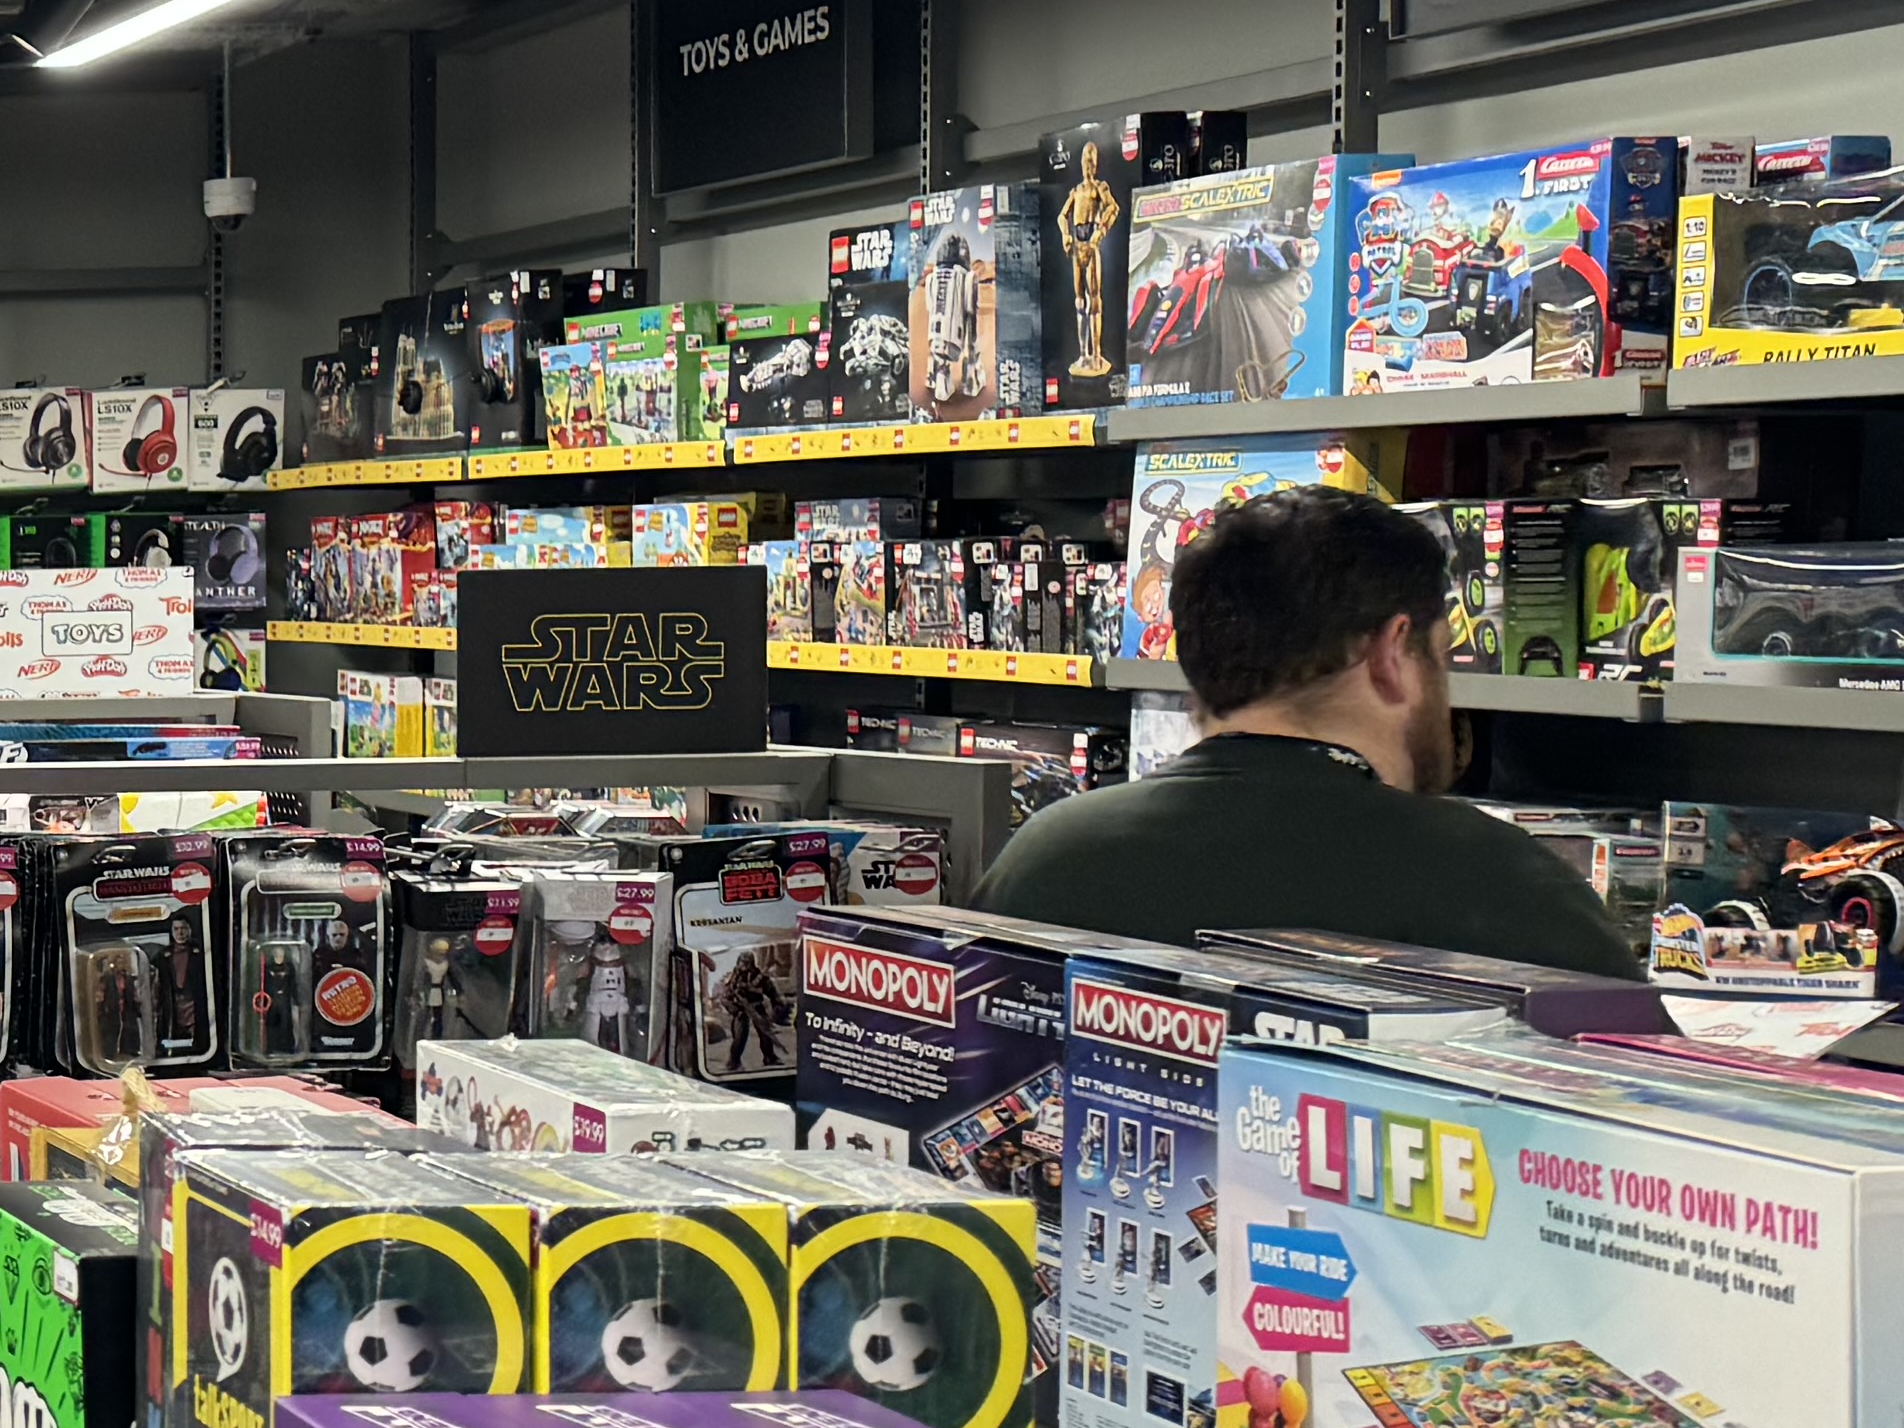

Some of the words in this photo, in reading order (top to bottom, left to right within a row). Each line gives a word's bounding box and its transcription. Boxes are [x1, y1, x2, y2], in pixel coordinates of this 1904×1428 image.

[678, 34, 730, 79] TOYS
[733, 28, 751, 60] &
[753, 4, 830, 57] GAMES
[51, 623, 123, 644] TOYS
[502, 613, 724, 662] STAR
[503, 661, 724, 712] WARS
[789, 838, 827, 852] £27.99
[809, 947, 949, 1014] MONOPOLY
[805, 1012, 821, 1027] To
[823, 1017, 866, 1043] Infinity
[875, 1030, 899, 1048] and
[902, 1036, 955, 1062] Beyond!
[1076, 990, 1221, 1057] MONOPOLY
[1250, 1085, 1280, 1123] the
[1235, 1106, 1301, 1157] Game
[1279, 1150, 1300, 1185] of
[1307, 1105, 1479, 1224] LIFE
[1518, 1148, 1604, 1201] CHOOSE
[1610, 1168, 1672, 1217] YOUR
[1679, 1184, 1737, 1232] OWN
[1746, 1198, 1820, 1250] PATH!
[1546, 1200, 1573, 1221] Take
[1577, 1213, 1585, 1226] a
[1588, 1213, 1614, 1234] spin
[1617, 1221, 1640, 1239] and
[1643, 1225, 1686, 1251] buckle
[1690, 1239, 1706, 1259] up
[1711, 1240, 1730, 1261] for
[1251, 1240, 1285, 1267] MAKE
[1287, 1249, 1317, 1273] YOUR
[1319, 1257, 1349, 1282] RIDE
[1539, 1226, 1570, 1248] turns
[1575, 1237, 1596, 1254] and
[1600, 1241, 1669, 1272] adventures
[1674, 1258, 1690, 1277] all
[1693, 1265, 1729, 1293] along
[1732, 1273, 1754, 1294] the
[1759, 1282, 1795, 1304] road!
[1253, 1301, 1345, 1340] COLOURFUL!
